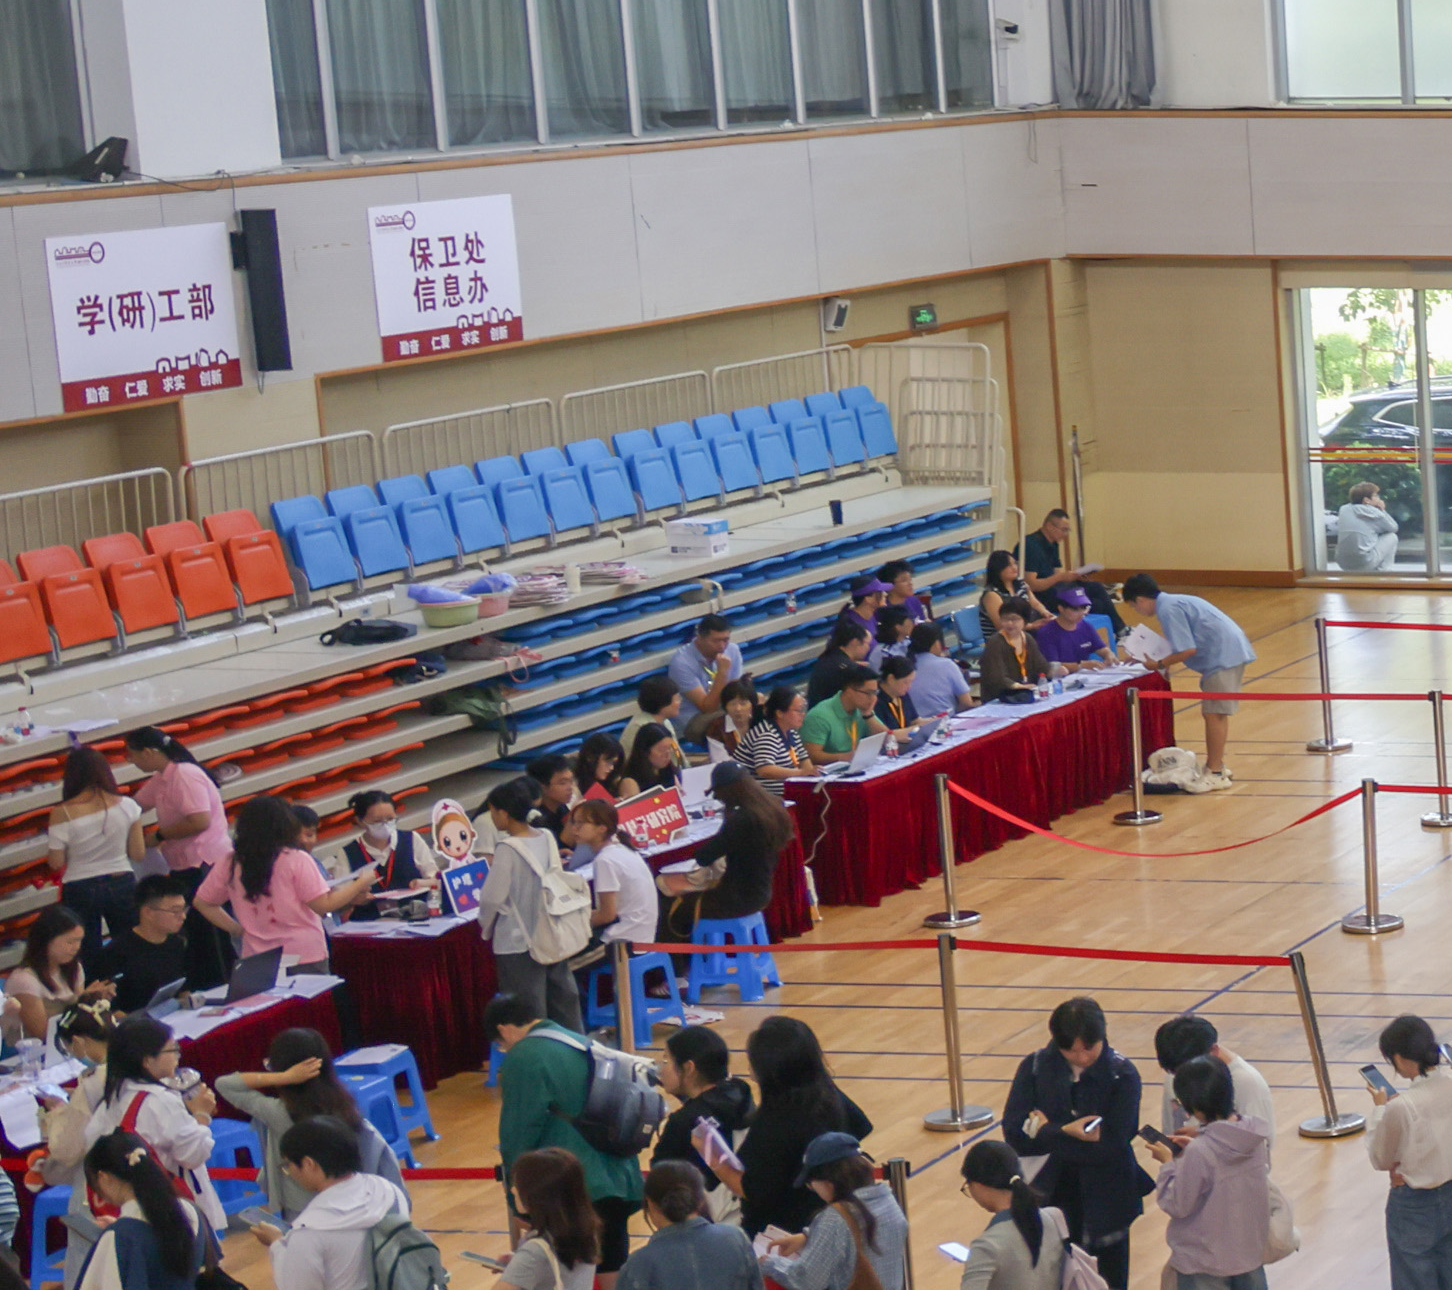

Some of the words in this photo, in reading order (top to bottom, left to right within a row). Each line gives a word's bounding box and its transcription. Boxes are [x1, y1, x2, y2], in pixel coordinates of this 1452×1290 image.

[409, 231, 486, 272] 保卫处
[77, 283, 215, 336] 学(研)工部
[413, 270, 489, 313] 信息办
[399, 339, 419, 355] 勤奋
[431, 334, 450, 351] 仁爱
[461, 329, 480, 345] 求实
[489, 325, 508, 341] 创新
[85, 386, 110, 404] 勤奋
[125, 379, 149, 398] 仁爱
[162, 374, 186, 392] 求实
[199, 369, 223, 386] 创新
